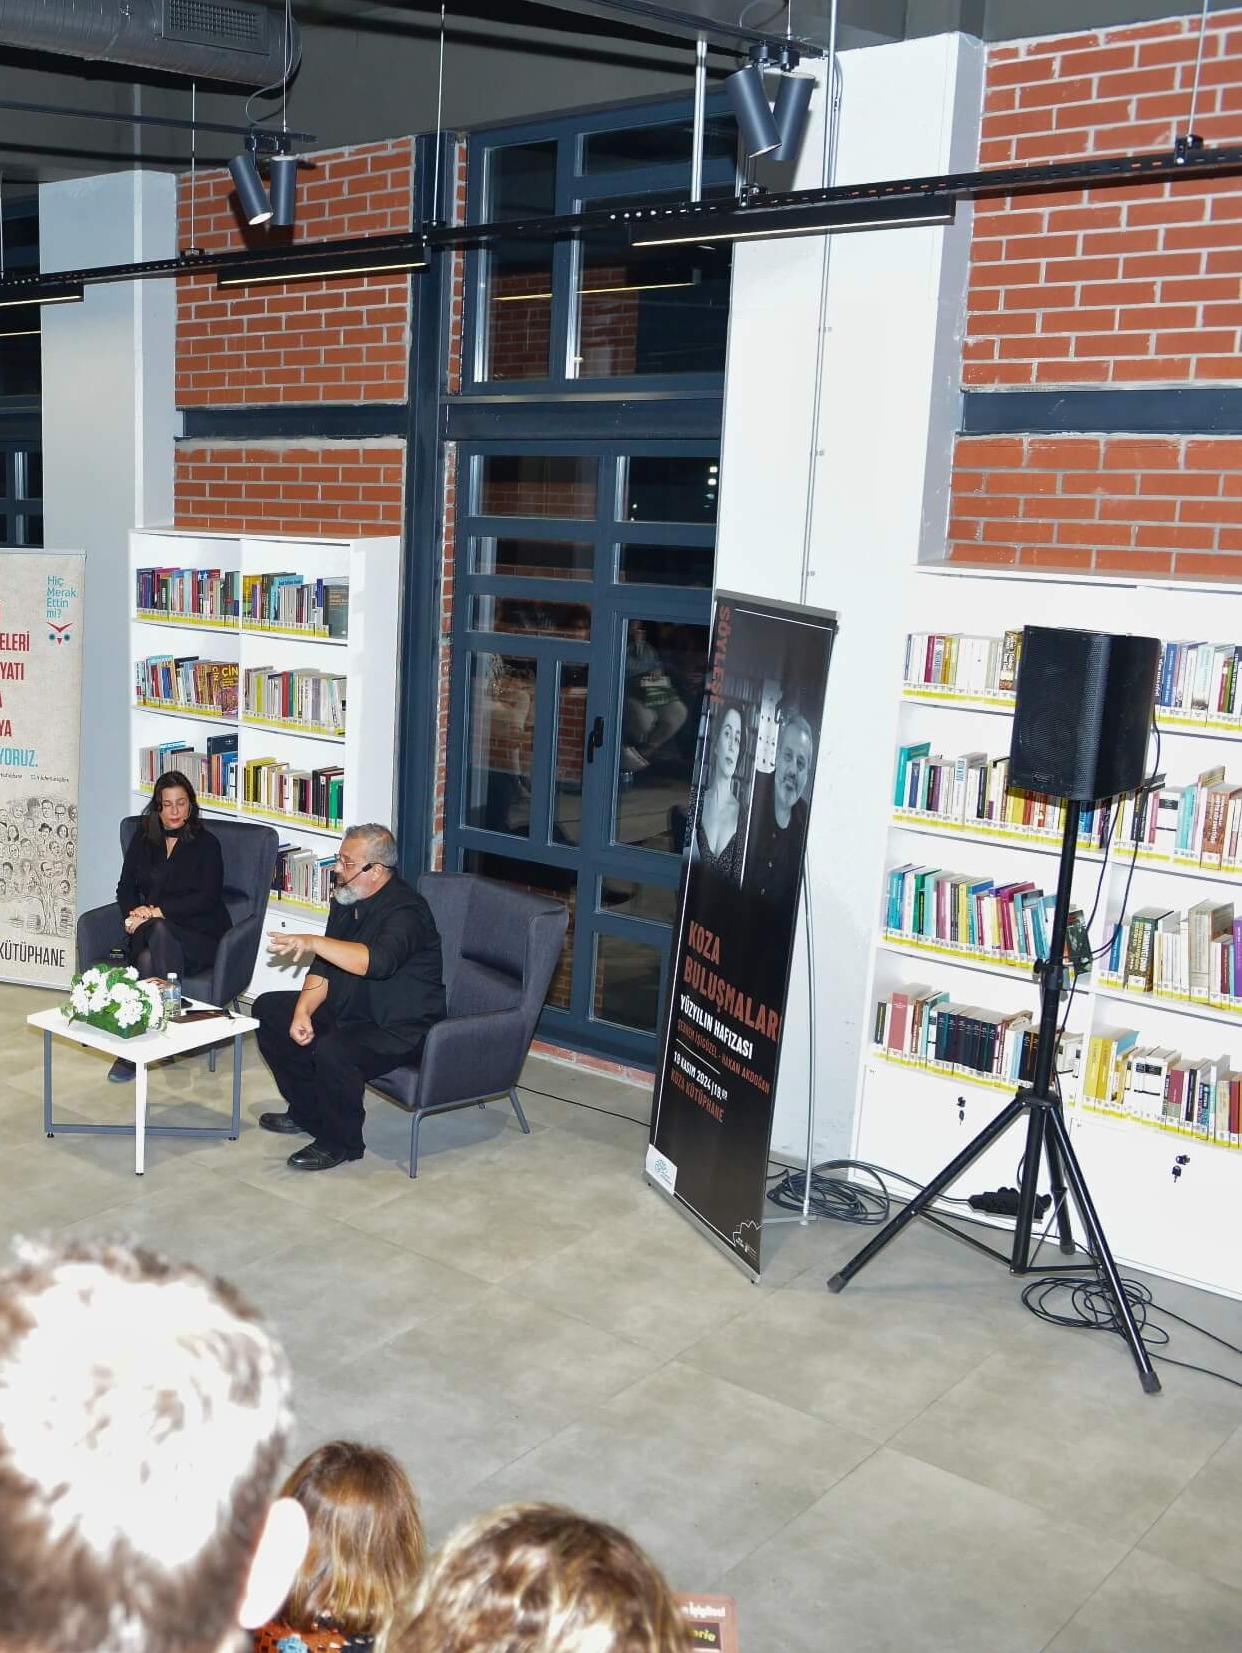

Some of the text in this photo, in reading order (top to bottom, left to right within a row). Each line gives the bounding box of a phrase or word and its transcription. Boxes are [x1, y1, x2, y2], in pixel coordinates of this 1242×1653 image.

[47, 587, 77, 597] Merak
[688, 920, 720, 965] KOZA
[680, 994, 754, 1060] YÜZYILIN HAFIZASI
[680, 1057, 696, 1078] KASIM
[671, 1067, 725, 1122] KOZA KÜTÜPHANE
